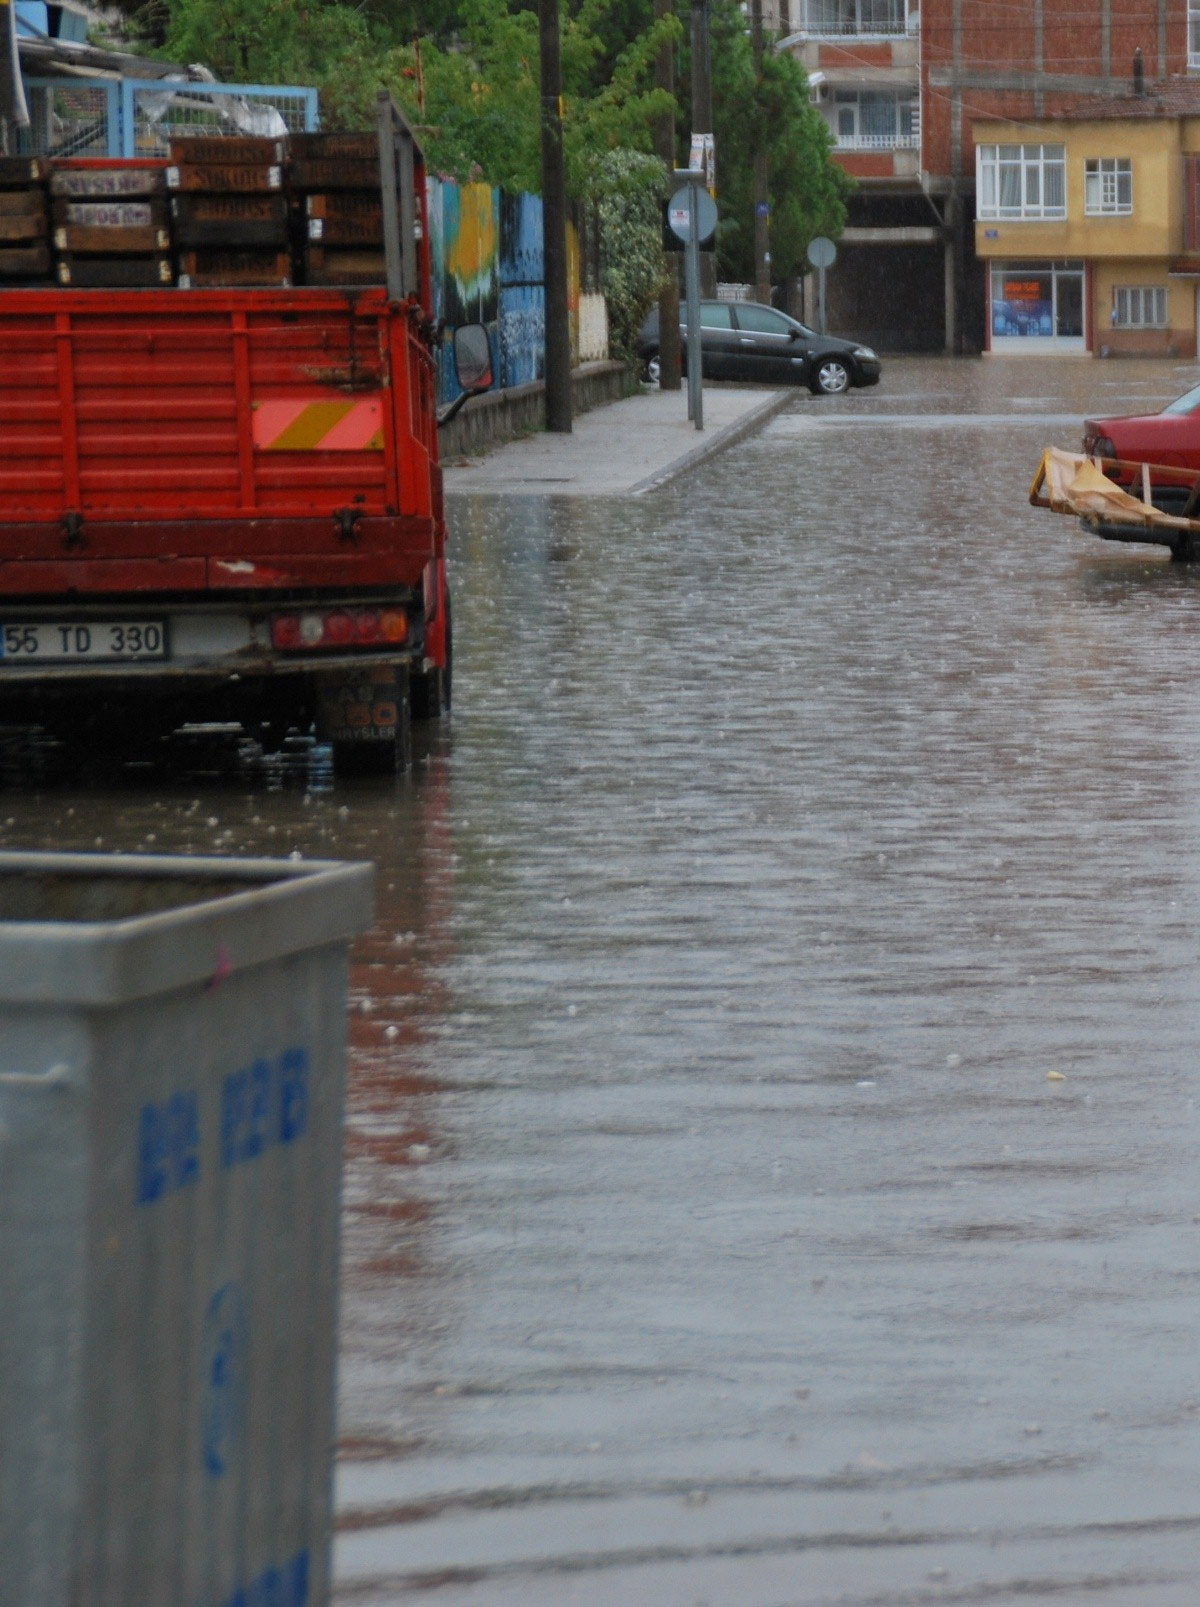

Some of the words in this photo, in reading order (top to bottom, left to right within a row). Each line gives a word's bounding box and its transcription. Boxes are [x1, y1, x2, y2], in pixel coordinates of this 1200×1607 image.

[5, 625, 39, 653] 55
[58, 625, 91, 653] TD
[110, 625, 160, 652] 330
